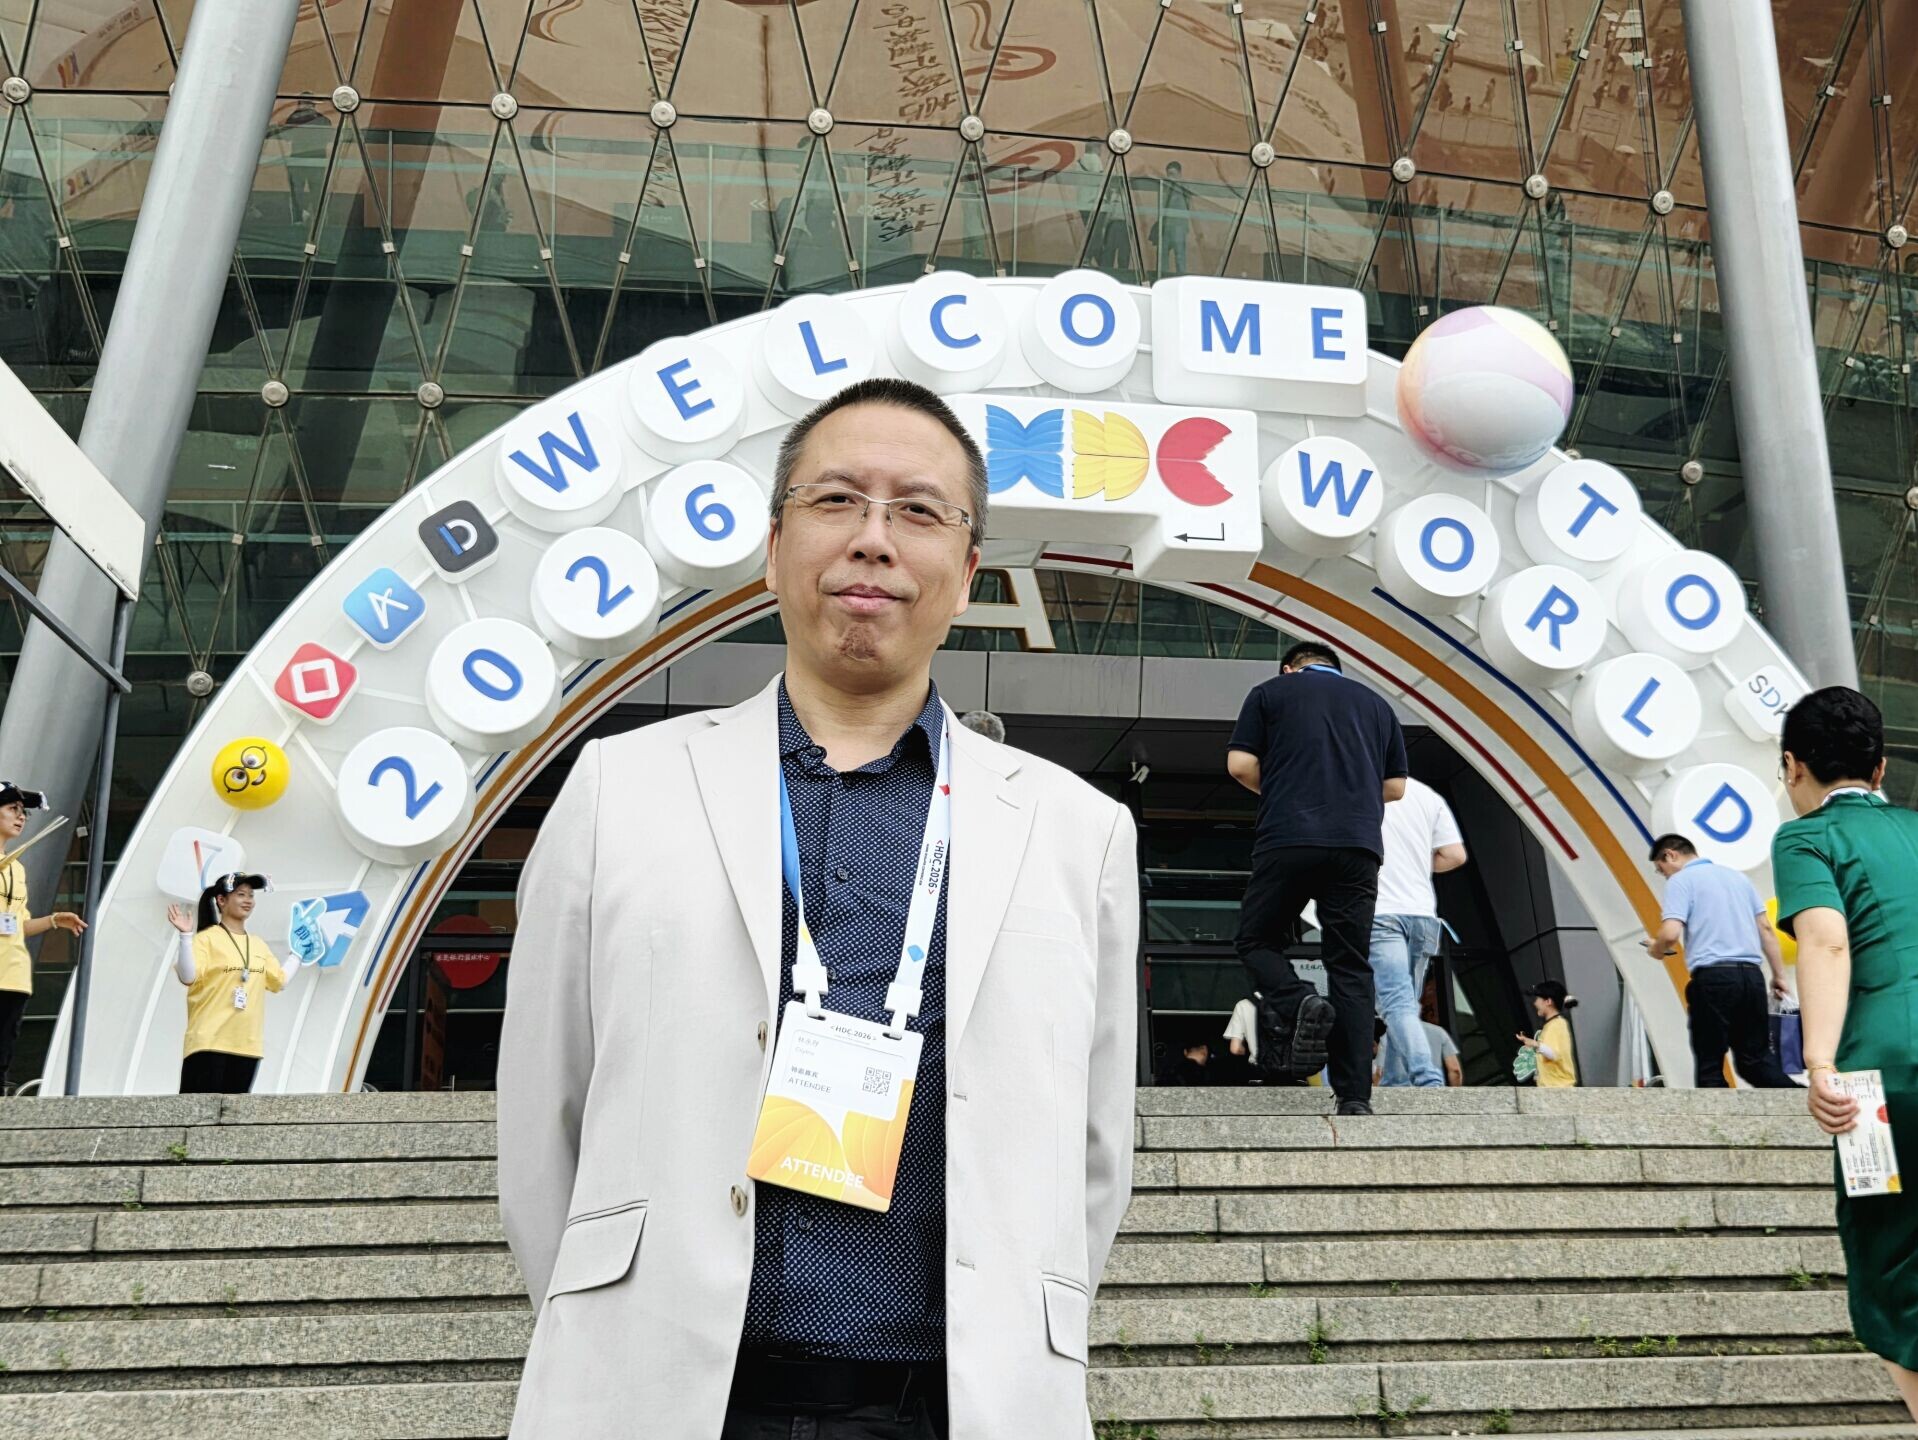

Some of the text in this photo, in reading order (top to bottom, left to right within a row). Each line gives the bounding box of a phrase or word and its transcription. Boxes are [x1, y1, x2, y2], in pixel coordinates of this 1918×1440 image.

[511, 293, 1720, 629] WELCOME TO
[368, 485, 734, 819] 2026
[1299, 452, 1752, 843] WORLD
[780, 1156, 864, 1188] ATTENDEE
[788, 1076, 832, 1093] ATTENDEE
